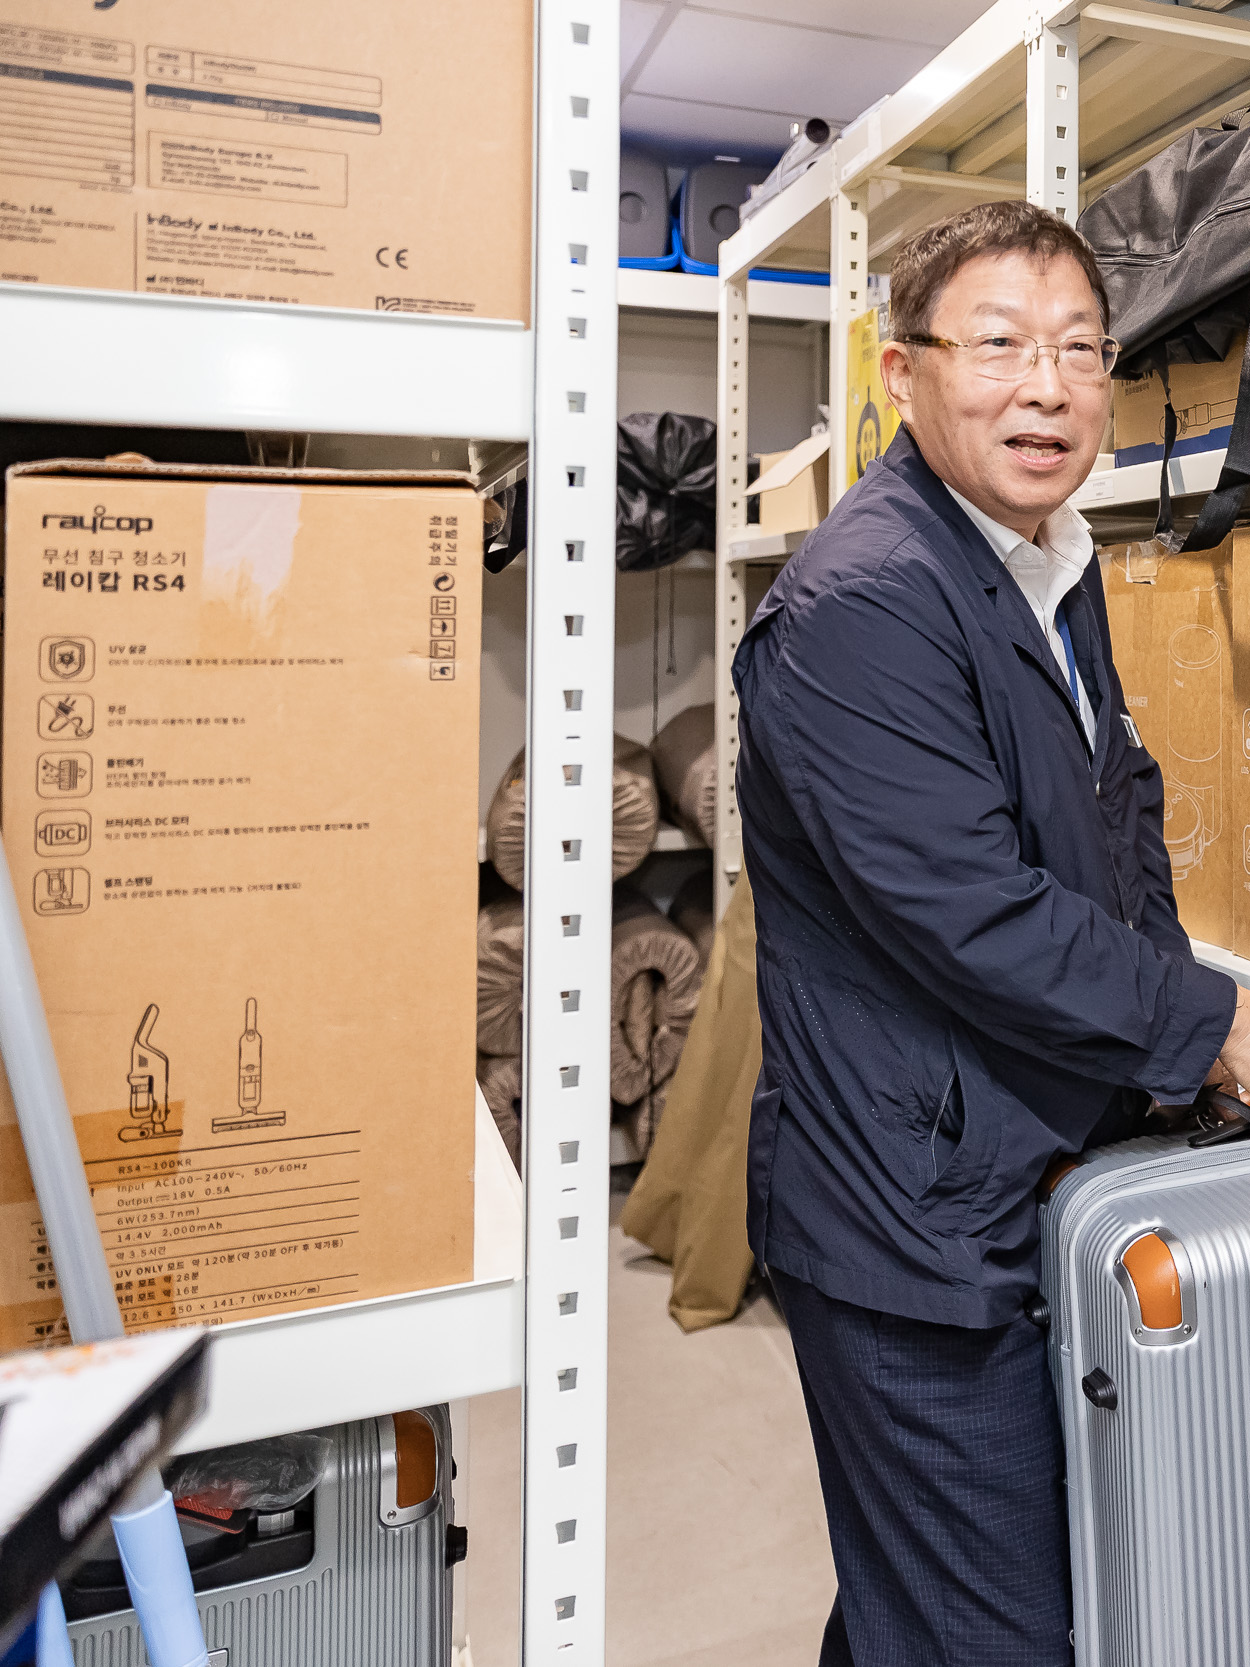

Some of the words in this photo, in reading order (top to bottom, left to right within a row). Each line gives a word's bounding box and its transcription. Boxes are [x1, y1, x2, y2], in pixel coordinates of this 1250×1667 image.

[376, 246, 408, 270] CE
[42, 505, 154, 536] raycop
[43, 549, 79, 566] 무선
[89, 549, 124, 566] 침구
[133, 550, 187, 567] 청소기
[42, 571, 121, 593] 레이캅
[133, 574, 186, 592] RS4
[109, 645, 126, 654] UV
[155, 817, 169, 826] DC
[54, 826, 76, 841] DC
[118, 1158, 192, 1175] RS4-100KR
[117, 1182, 145, 1194] Input
[254, 1162, 308, 1177] 50/60Hz
[204, 1186, 231, 1196] 0.5A
[117, 1208, 200, 1226] 6W(253.7nm)
[117, 1230, 152, 1243] 14.4V
[162, 1221, 223, 1239] 2,000mAh
[115, 1269, 132, 1279] UV
[136, 1264, 164, 1276] ONLY
[280, 1245, 299, 1256] OFF
[171, 1304, 193, 1316] 250
[213, 1296, 245, 1310] 141.7
